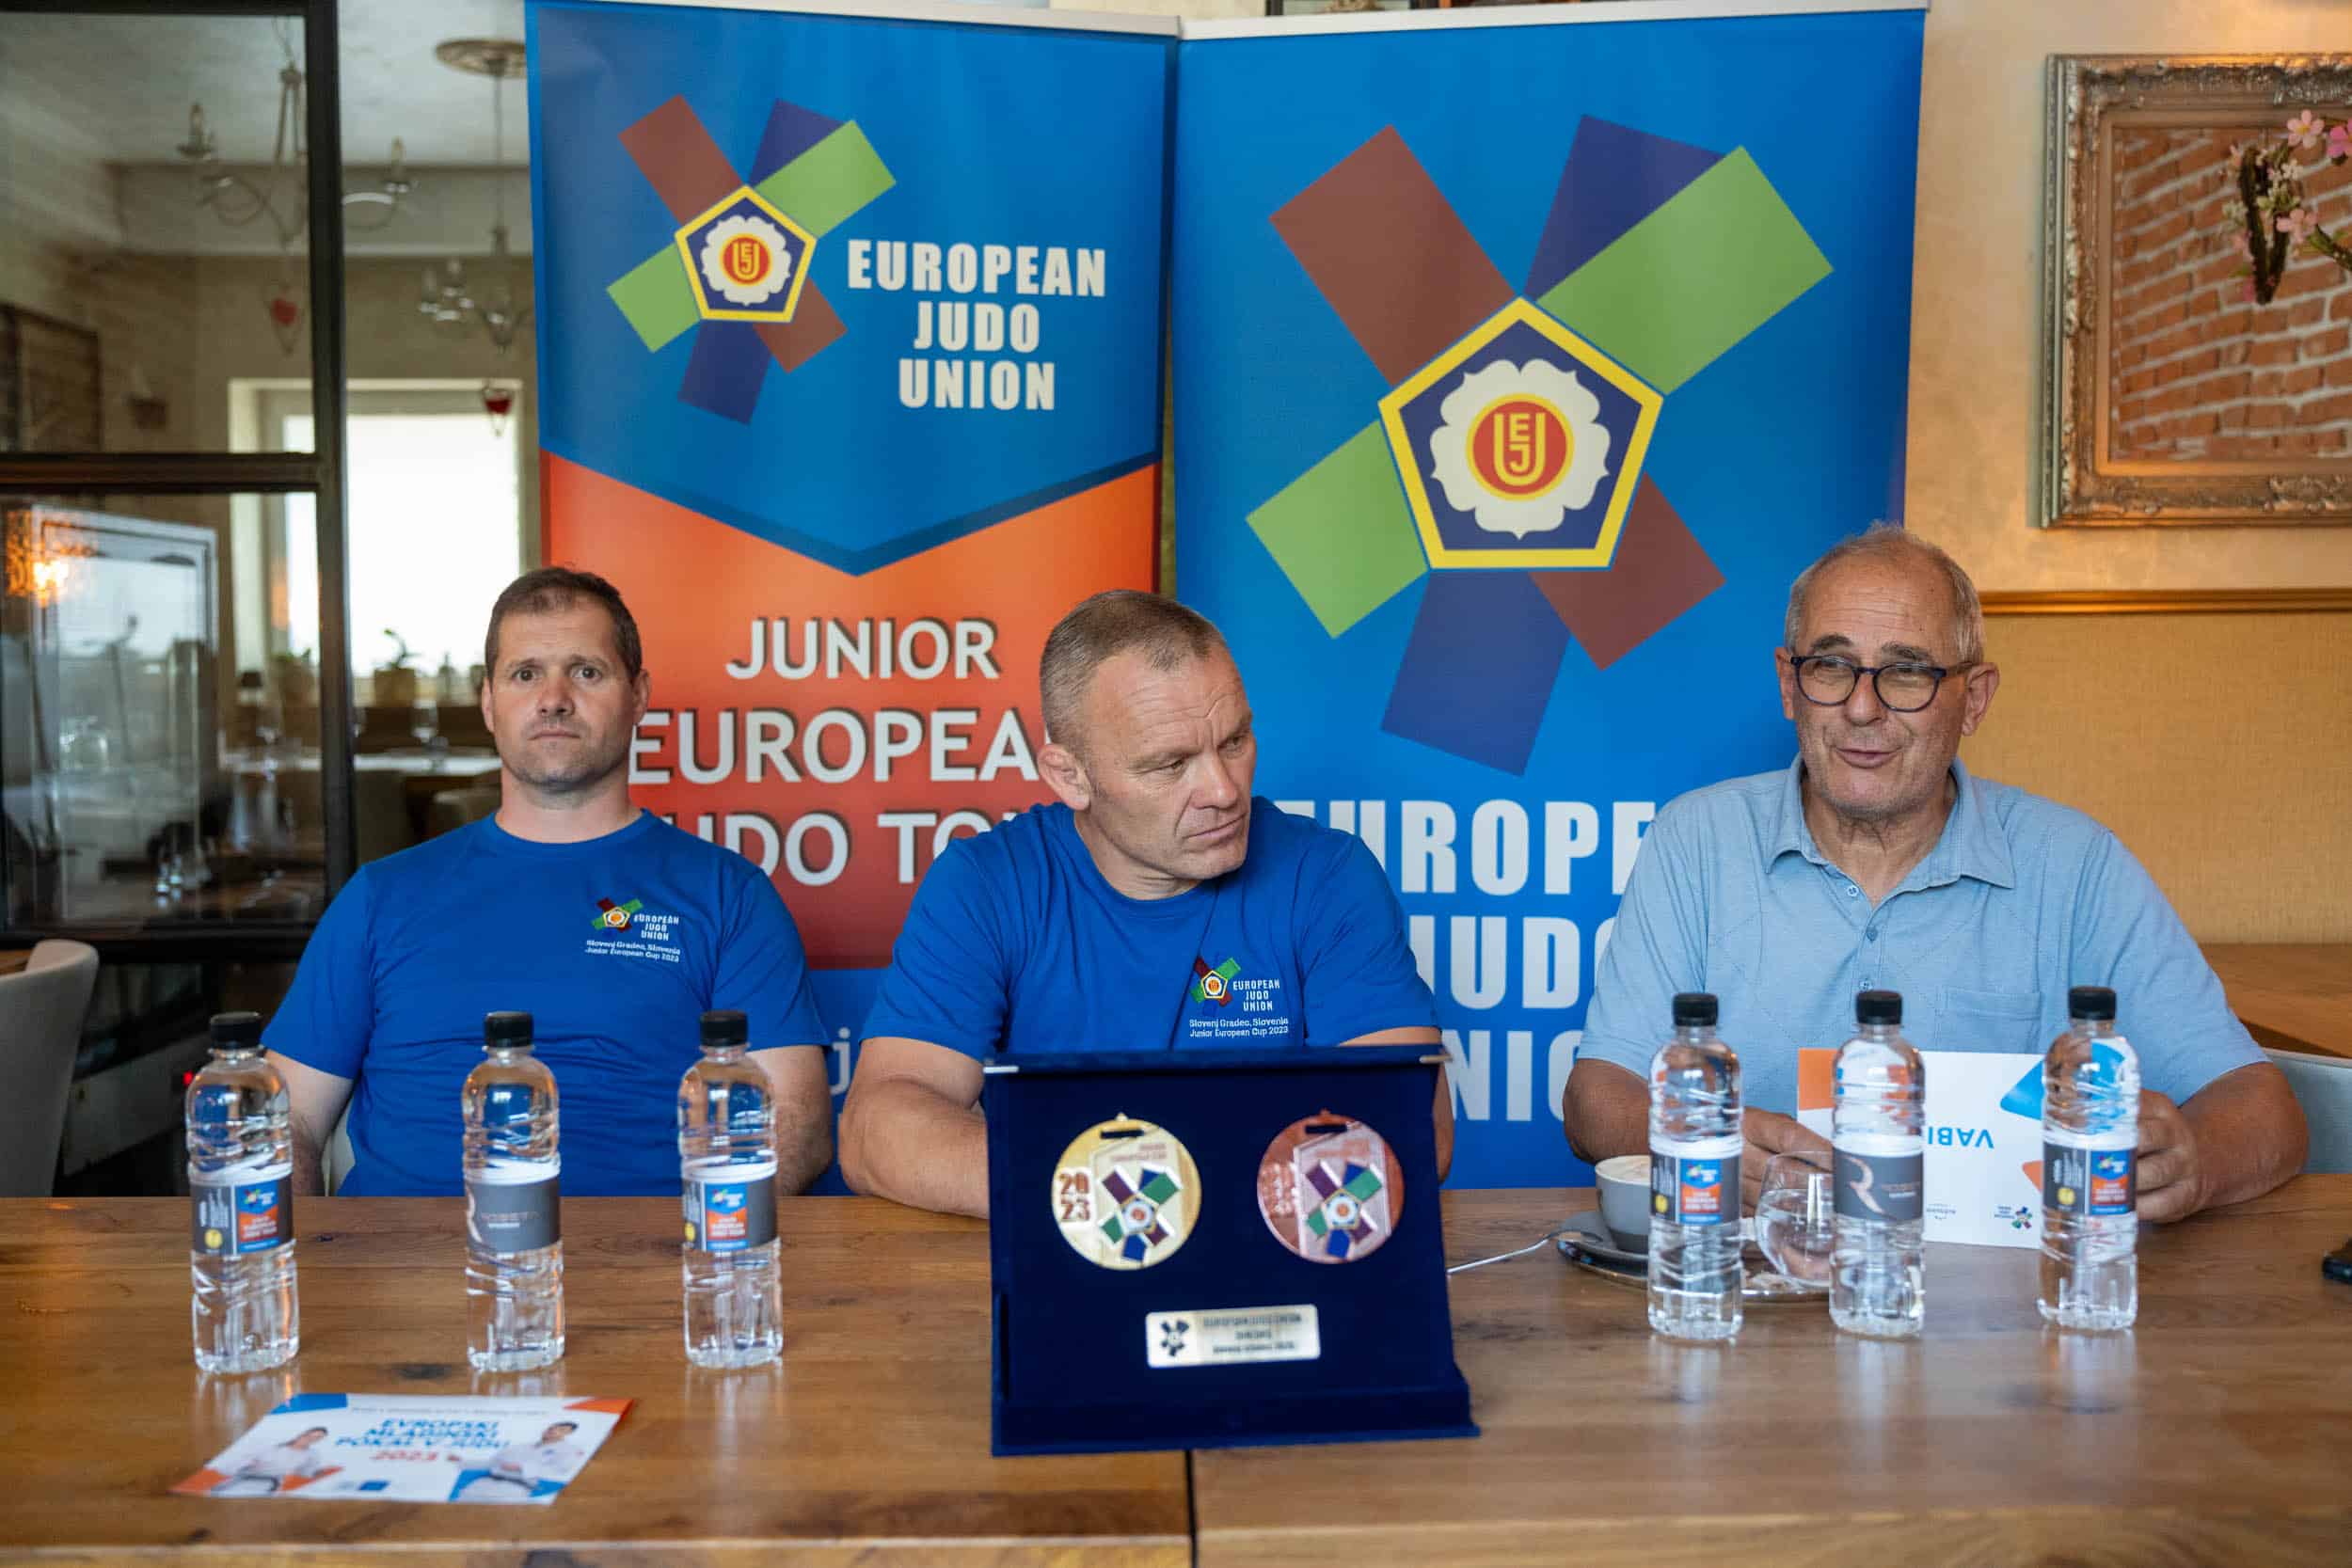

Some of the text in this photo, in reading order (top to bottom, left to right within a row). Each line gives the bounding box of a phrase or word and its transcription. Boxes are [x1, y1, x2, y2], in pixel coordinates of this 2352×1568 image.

[848, 239, 1105, 297] EUROPEAN
[914, 300, 1040, 353] JUDO
[898, 358, 1055, 410] UNION
[724, 620, 1000, 680] JUNIOR
[628, 709, 1049, 784] EUROPEA
[661, 812, 849, 887] DO
[634, 913, 679, 925] EUROPEAN
[641, 929, 669, 941] UNION
[1409, 915, 1616, 1010] JUD
[1232, 979, 1280, 990] EUROPEAN
[1246, 990, 1269, 1001] JUDO
[1243, 1001, 1273, 1012] UNION
[1189, 1025, 1288, 1038] Junior European Cup 2023
[1252, 1016, 1289, 1027] Slovenia
[1928, 1126, 1994, 1149] VABI
